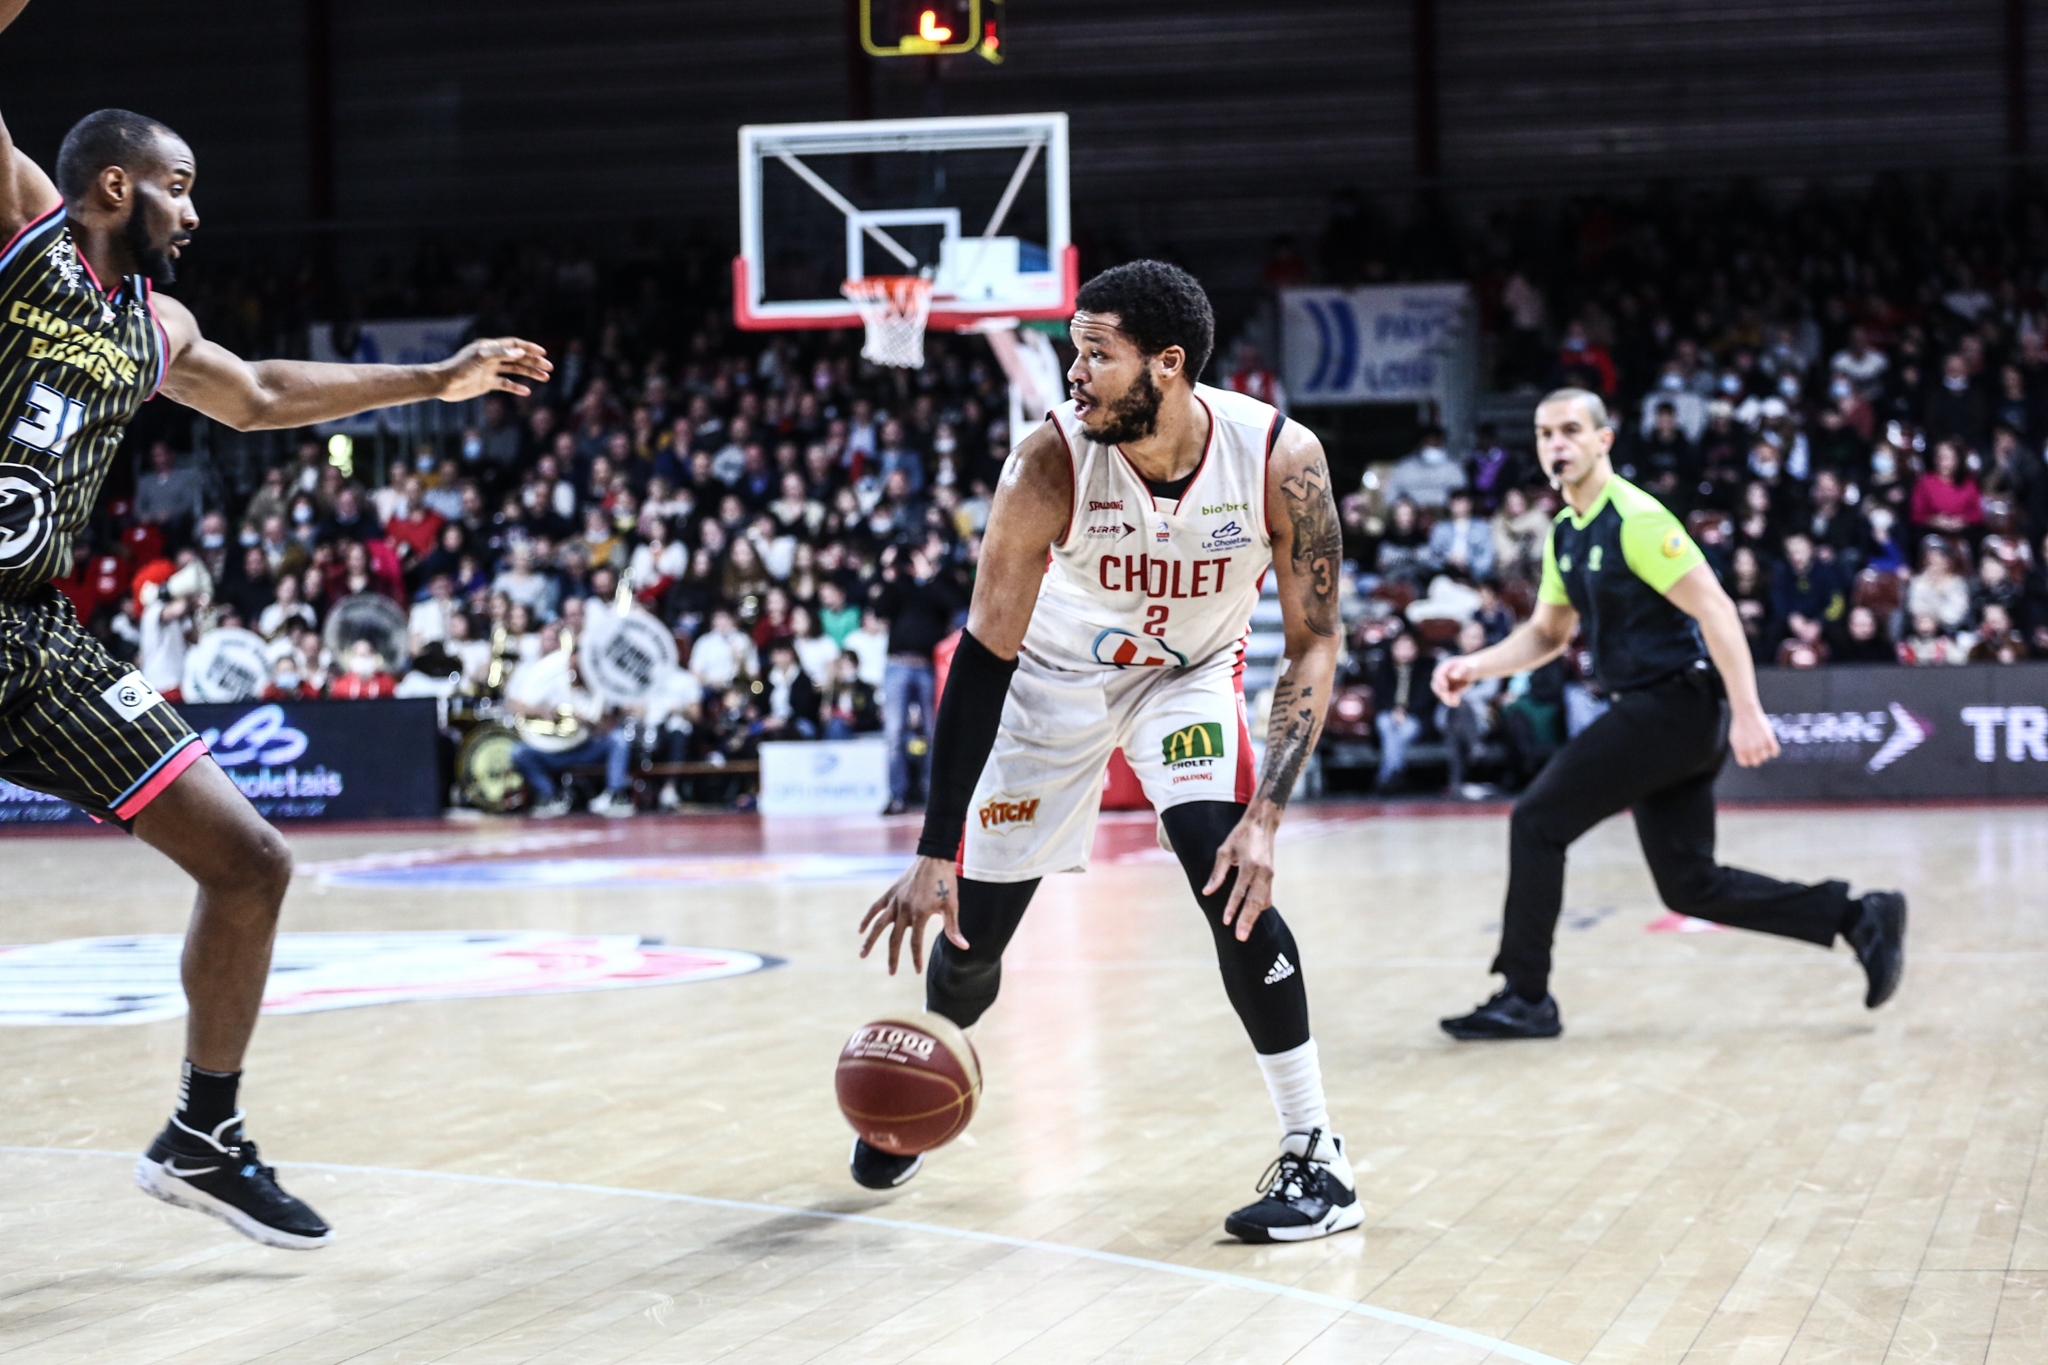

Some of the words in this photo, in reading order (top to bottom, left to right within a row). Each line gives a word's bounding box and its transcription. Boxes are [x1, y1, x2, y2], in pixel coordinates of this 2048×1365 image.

[8, 380, 87, 459] 31
[1201, 502, 1249, 516] bio'brc
[1099, 552, 1232, 599] CHOLET
[1142, 604, 1171, 638] 2
[1171, 759, 1215, 772] CHOLET
